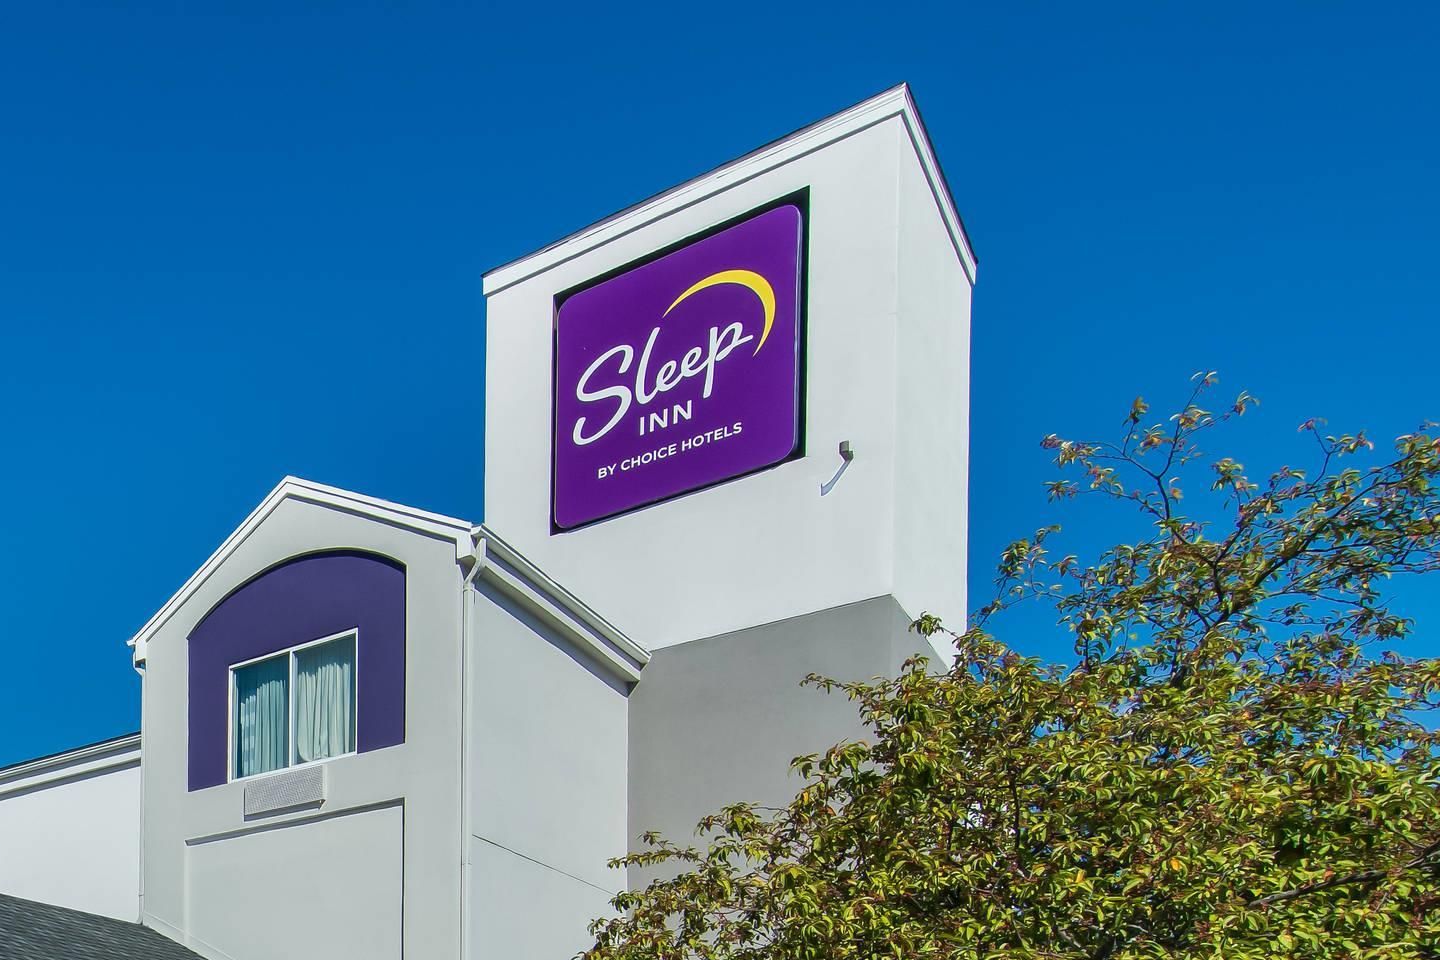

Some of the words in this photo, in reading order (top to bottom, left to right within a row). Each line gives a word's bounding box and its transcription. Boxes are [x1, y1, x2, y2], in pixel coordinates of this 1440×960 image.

[572, 322, 753, 446] Sleep
[639, 400, 692, 436] INN
[597, 465, 617, 479] BY
[620, 445, 677, 471] CHOICE
[681, 422, 743, 451] HOTELS
